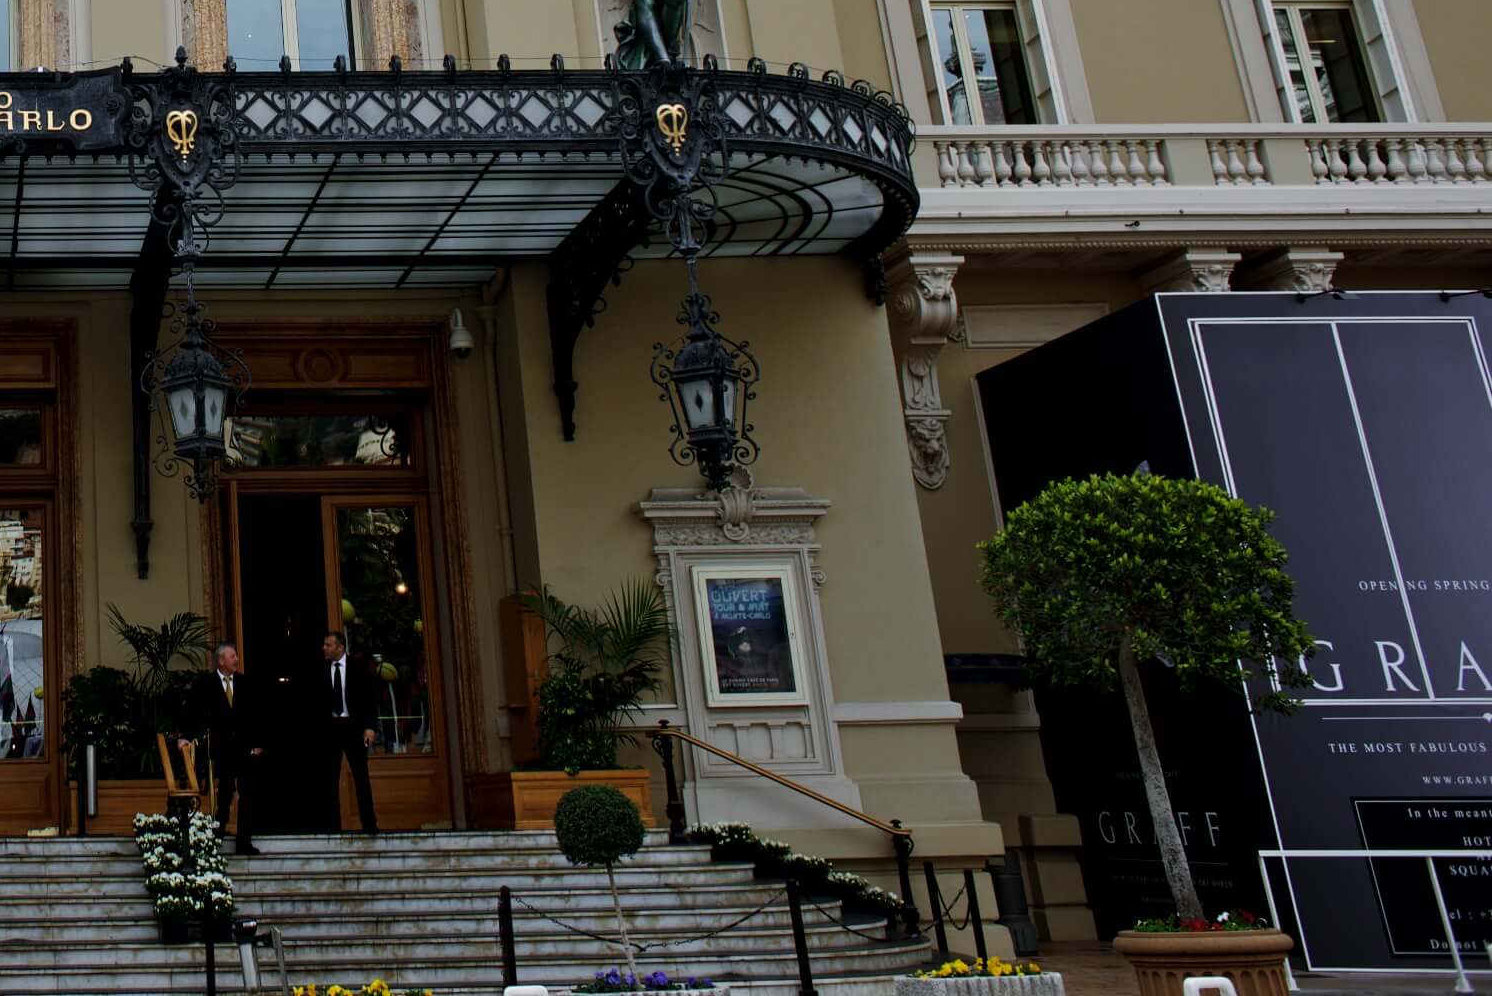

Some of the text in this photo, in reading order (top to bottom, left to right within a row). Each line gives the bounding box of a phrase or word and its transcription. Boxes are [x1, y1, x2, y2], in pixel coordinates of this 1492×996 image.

[1358, 580, 1490, 591] OPENNG SPRING
[711, 589, 767, 603] OUVERT
[1327, 742, 1487, 753] THE MOST FABULOUS
[1408, 807, 1421, 818] In
[1428, 807, 1448, 818] the
[1098, 810, 1220, 848] GRFF
[1449, 865, 1492, 877] SQUA
